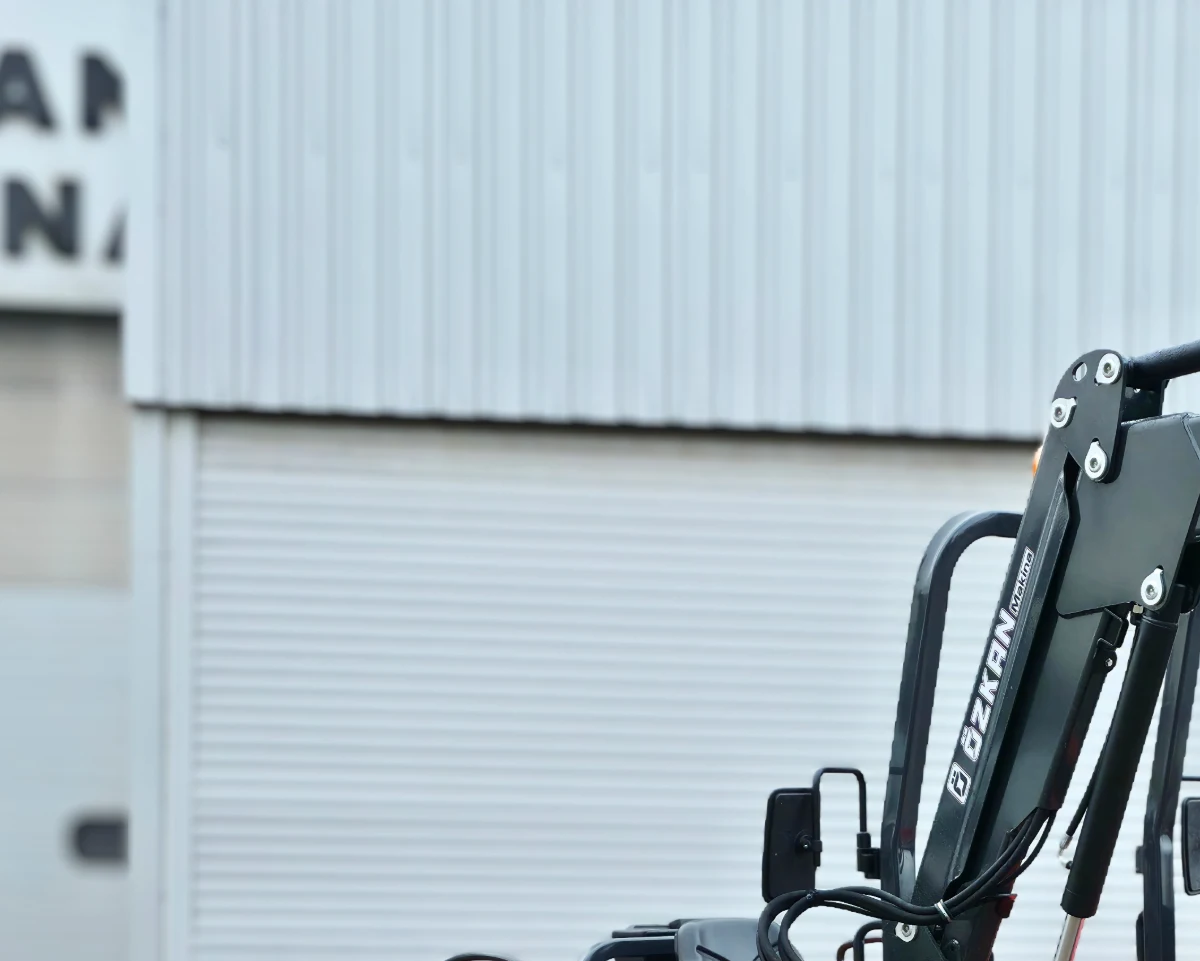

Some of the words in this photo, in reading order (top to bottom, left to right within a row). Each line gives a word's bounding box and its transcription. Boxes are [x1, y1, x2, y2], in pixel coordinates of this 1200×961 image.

[4, 178, 126, 264] N
[961, 608, 1017, 762] ÖZKAN
[1010, 551, 1033, 613] Makina
